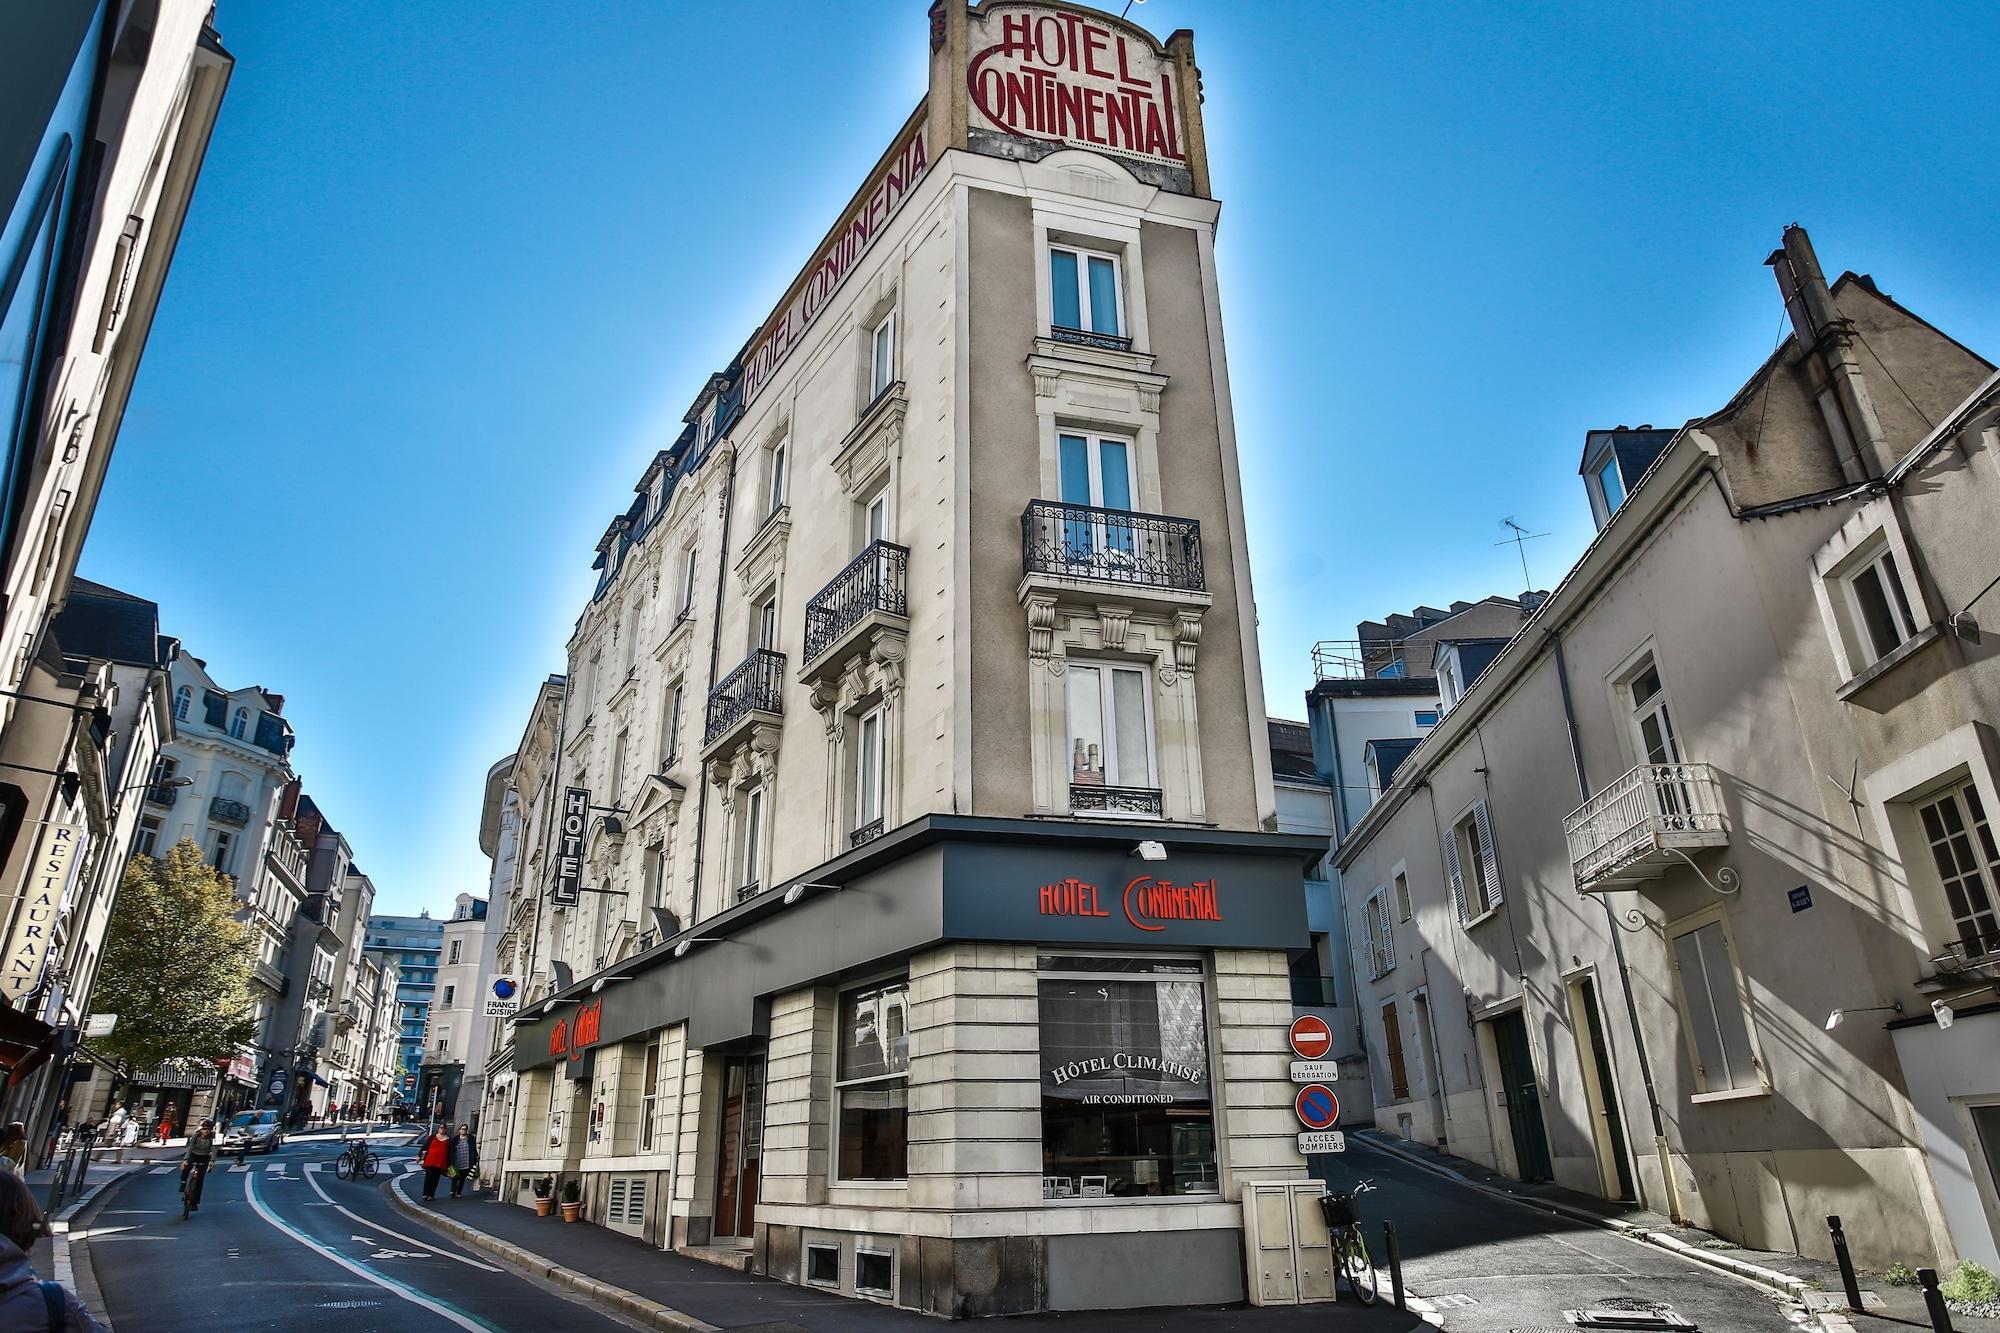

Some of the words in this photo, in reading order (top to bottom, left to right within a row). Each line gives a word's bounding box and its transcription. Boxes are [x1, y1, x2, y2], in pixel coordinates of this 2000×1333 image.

[1003, 12, 1151, 88] HOTEL
[967, 43, 1186, 160] CONTINENTAL
[742, 309, 798, 406] HOTEL
[802, 130, 927, 323] CONTINENTA
[557, 794, 586, 900] HOTEL
[10, 828, 71, 990] RESTAURANT
[1039, 878, 1110, 917] HOTEL
[1123, 875, 1222, 931] CONTINENTAL
[486, 1008, 517, 1016] LOISIRS
[487, 1001, 517, 1009] FRANCE
[1051, 1060, 1110, 1086] HÔTEL
[1113, 1052, 1201, 1085] CLIMATISÉ
[1292, 1071, 1337, 1079] DÉROGATION
[1082, 1094, 1101, 1104] AIR
[1102, 1094, 1174, 1104] CONDITIONED
[1300, 1142, 1344, 1151] POMPIERS
[1307, 1133, 1335, 1143] ACCÈS
